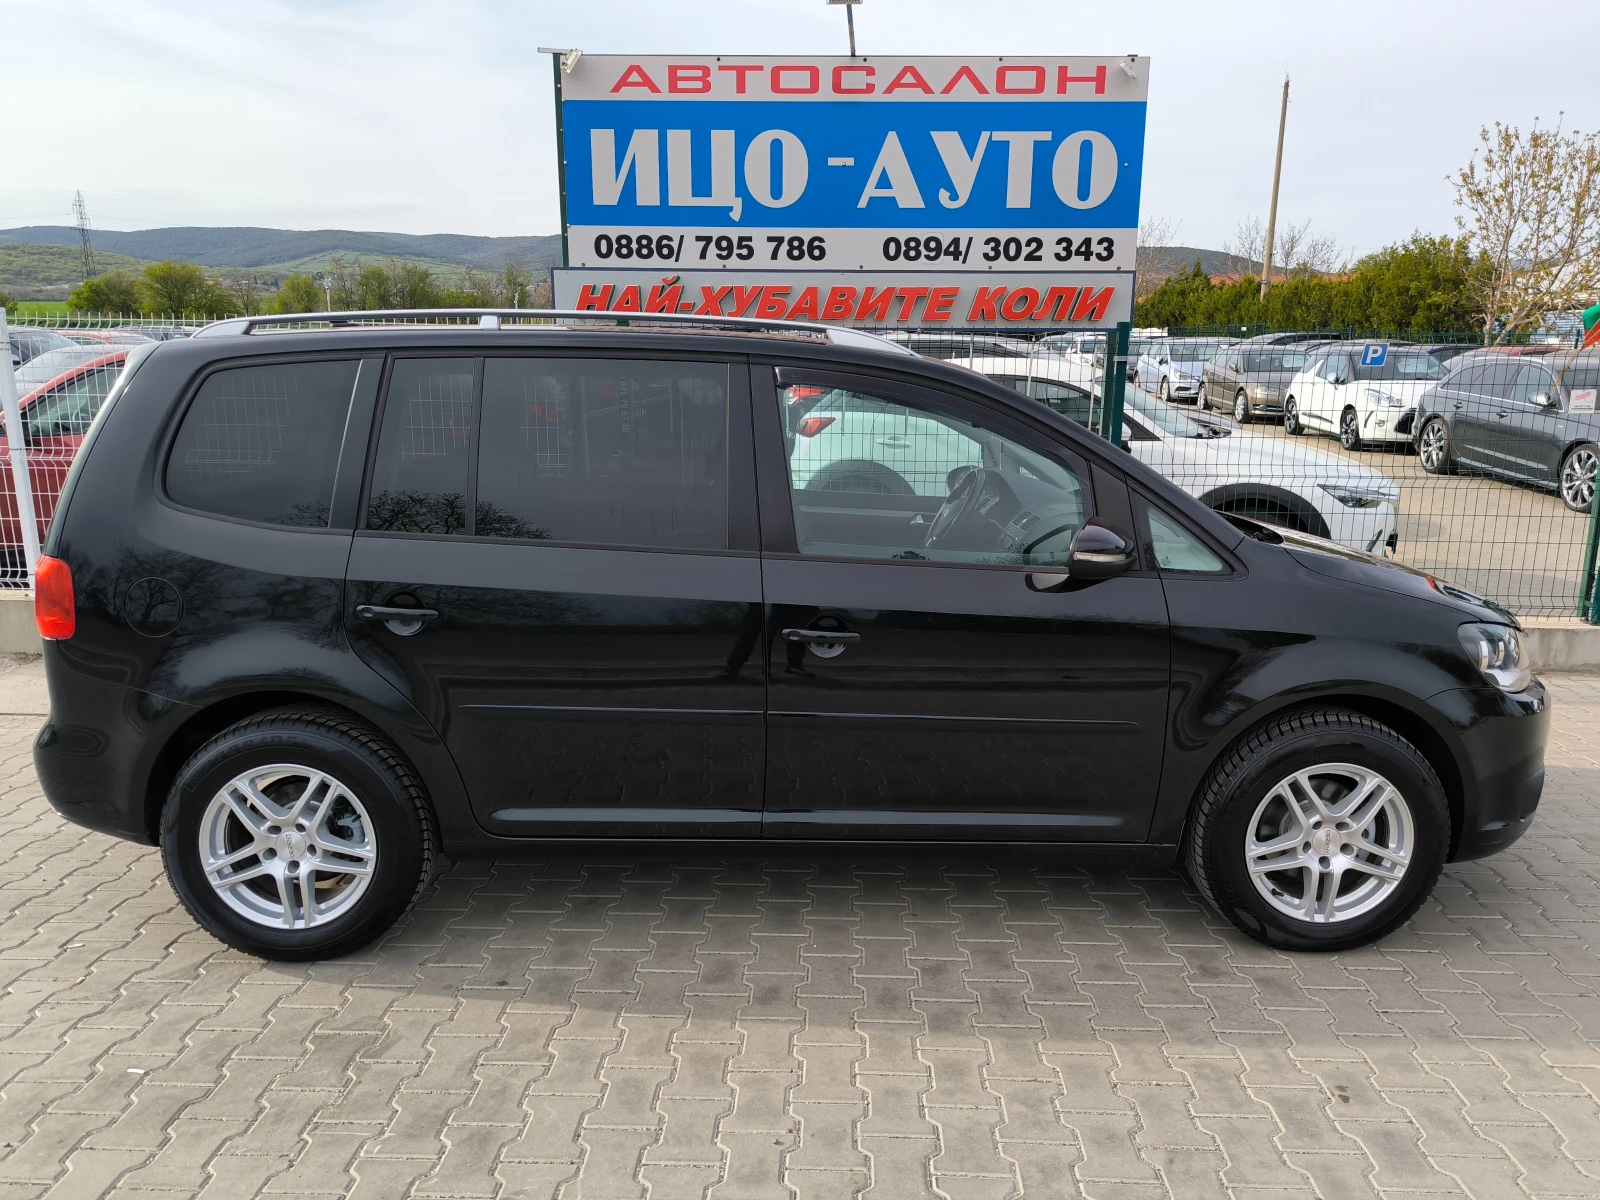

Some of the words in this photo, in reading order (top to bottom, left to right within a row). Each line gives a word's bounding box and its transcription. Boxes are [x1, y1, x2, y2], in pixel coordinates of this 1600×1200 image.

[611, 64, 1107, 96] АВТОСАЛОН
[594, 234, 685, 263] 0886/
[694, 235, 755, 261] 795
[766, 235, 827, 262] 786
[882, 236, 974, 264] 0894/
[982, 236, 1044, 262] 302
[1053, 236, 1115, 262] 343
[574, 275, 961, 322] НАЙ-ХУБАВИТЕ
[966, 285, 1116, 322] КОЛИ
[1365, 345, 1383, 364] P
